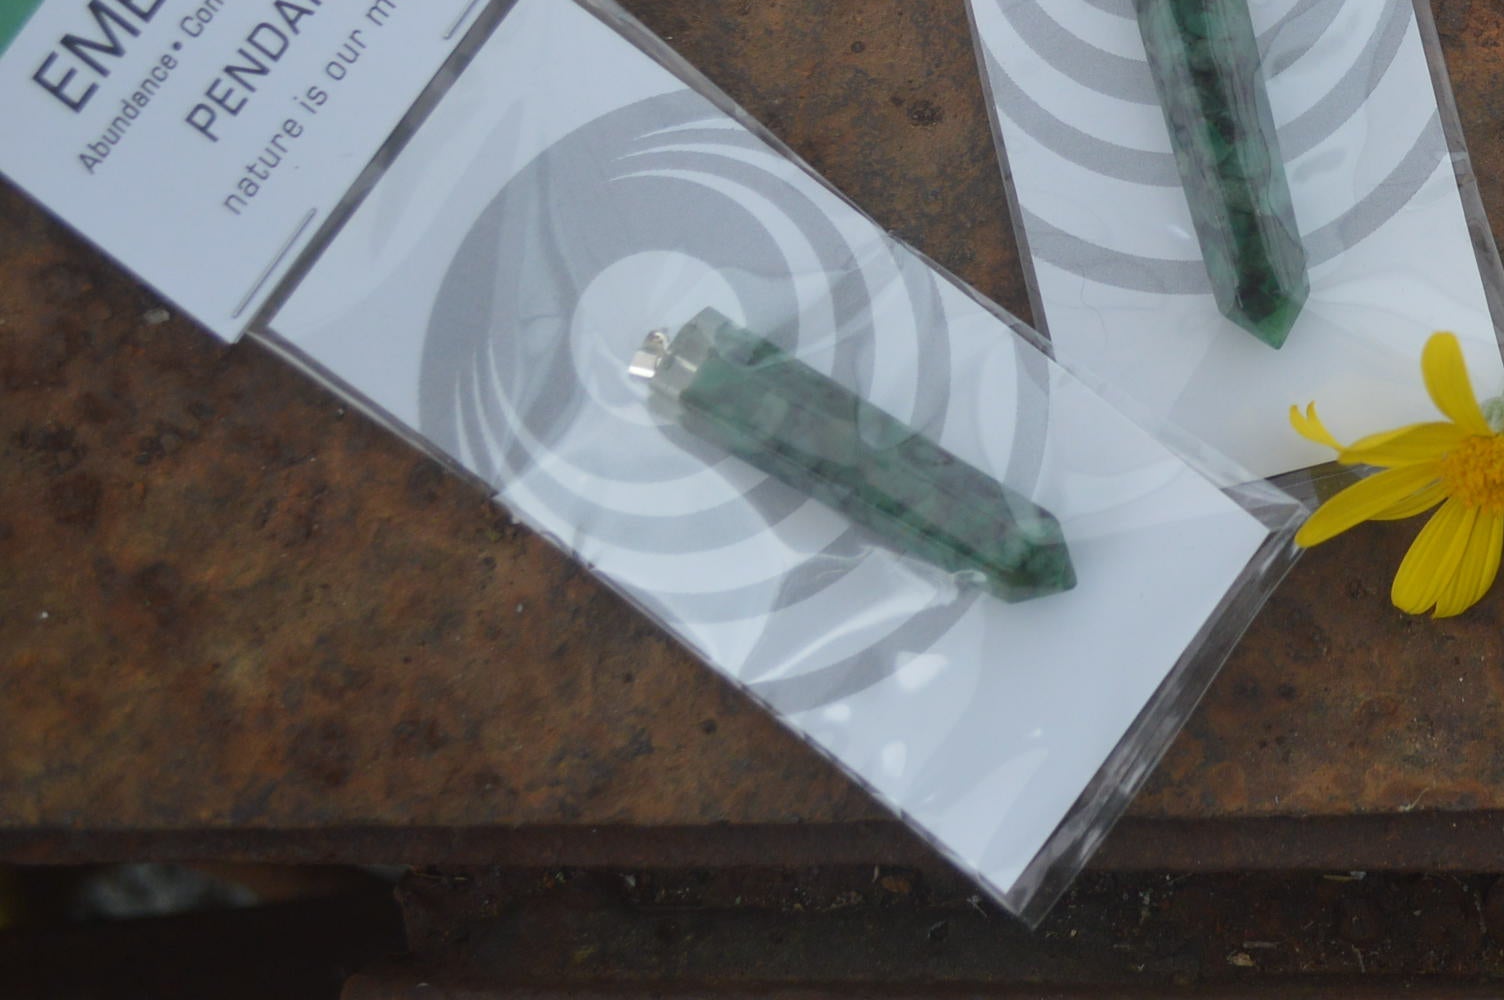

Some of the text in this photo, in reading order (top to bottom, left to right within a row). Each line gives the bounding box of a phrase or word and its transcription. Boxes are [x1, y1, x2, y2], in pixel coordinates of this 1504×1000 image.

[224, 119, 303, 214] nature
[293, 86, 329, 115] is
[325, 30, 366, 81] our
